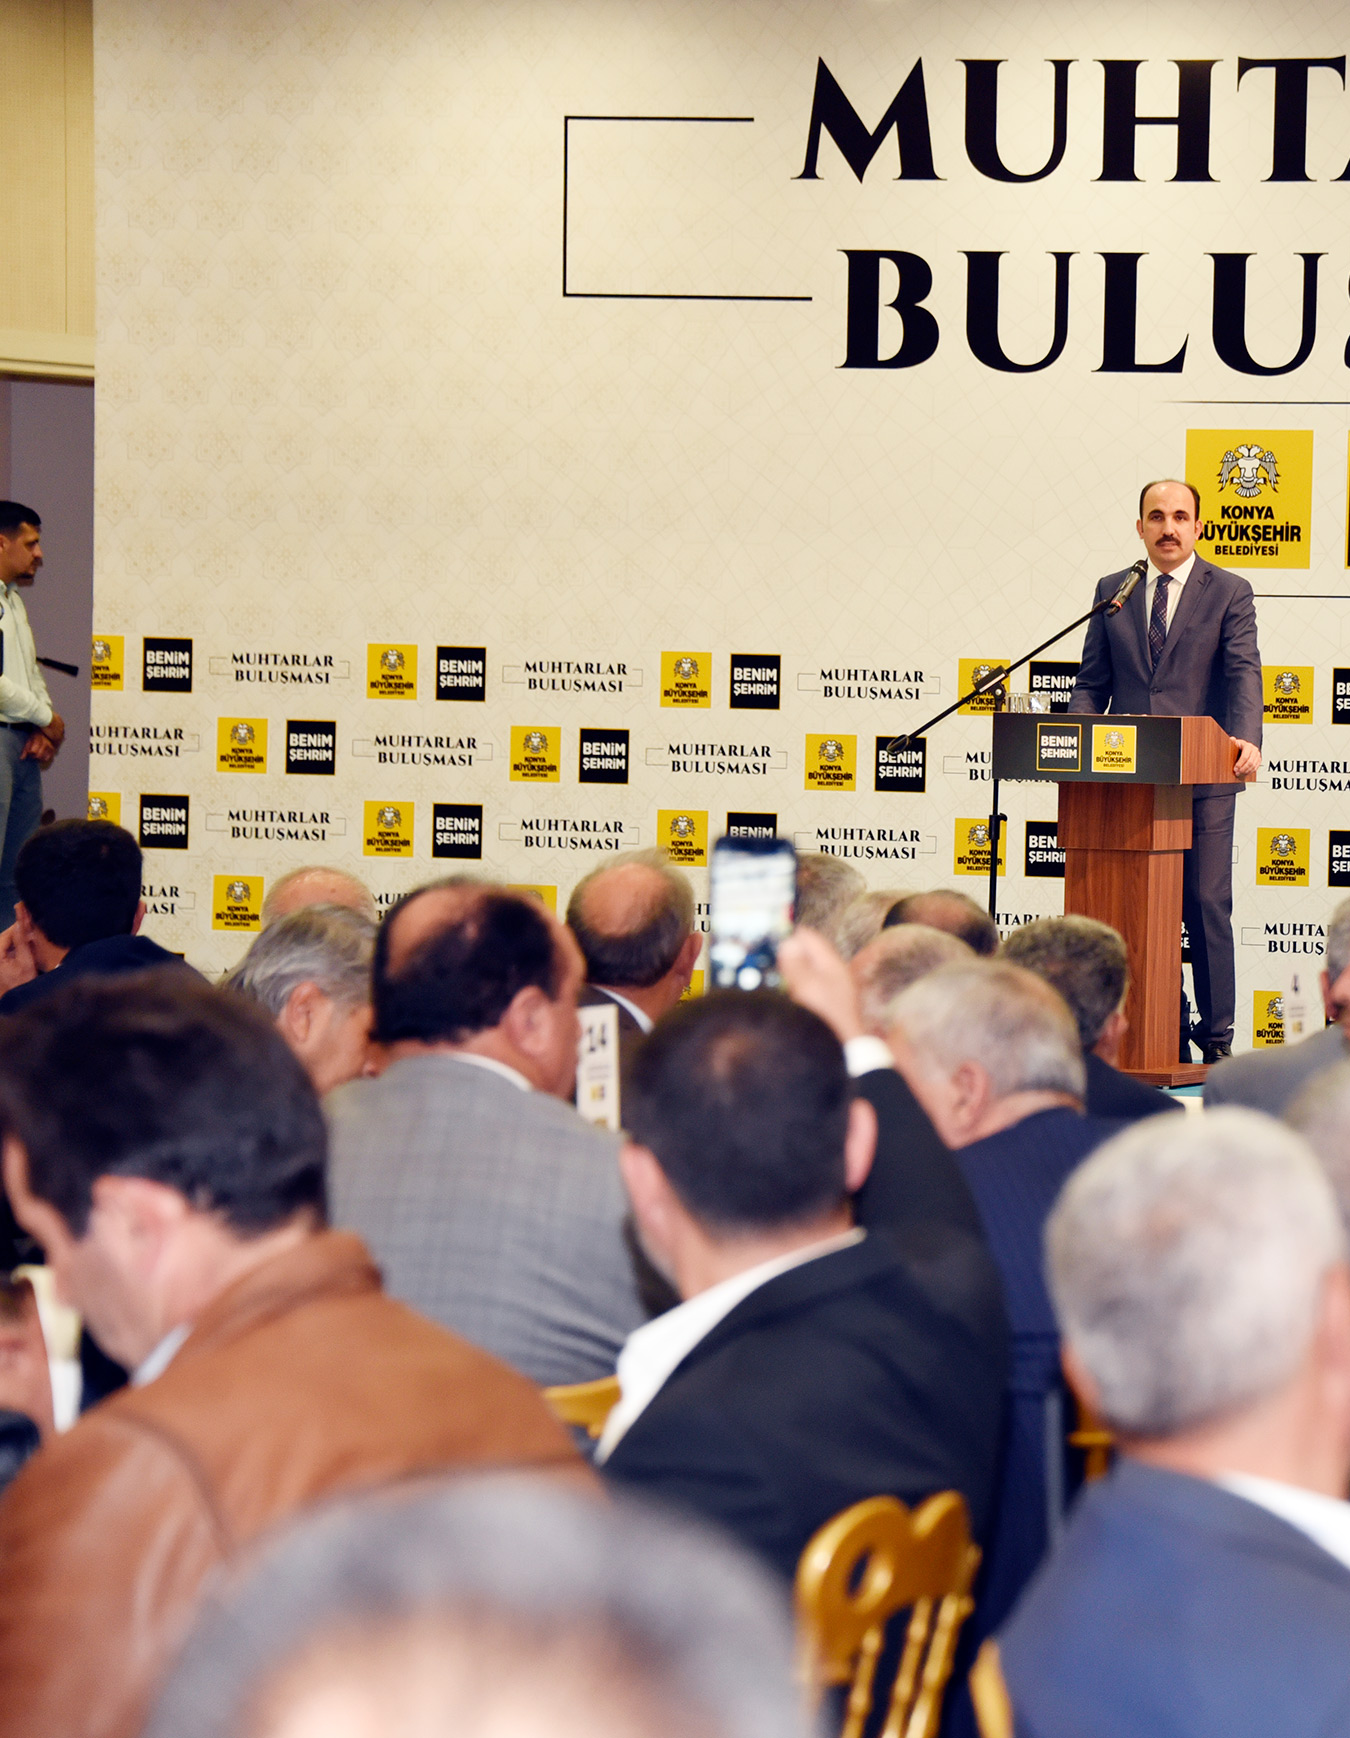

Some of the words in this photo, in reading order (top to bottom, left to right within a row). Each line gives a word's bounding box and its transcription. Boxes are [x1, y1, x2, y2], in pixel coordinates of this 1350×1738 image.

[1220, 505, 1275, 520] KONYA
[1214, 544, 1279, 557] BELEDİYESİ
[231, 654, 335, 666] MUHTARLAR
[524, 662, 628, 674] MUHTARLAR
[235, 670, 329, 683] BULUŞMASI
[819, 669, 925, 682] MUHTARLAR
[528, 679, 623, 692] BULUŞMASI
[823, 686, 920, 699] BULUŞMASI
[374, 736, 478, 748] MUHTARLAR
[667, 744, 772, 757] MUHTARLAR
[378, 752, 472, 765] BULUŞMASI
[671, 761, 767, 774] BULUŞMASI
[227, 810, 331, 823] MUHTARLAR
[520, 819, 625, 832] MUHTARLAR
[231, 827, 326, 840] BULUŞMASI
[816, 828, 921, 841] MUHTARLAR
[524, 836, 619, 849] BULUŞMASI
[820, 845, 916, 860] BULUŞMASI
[1263, 922, 1330, 938] MUHTA
[1267, 940, 1328, 956] BULUŞ
